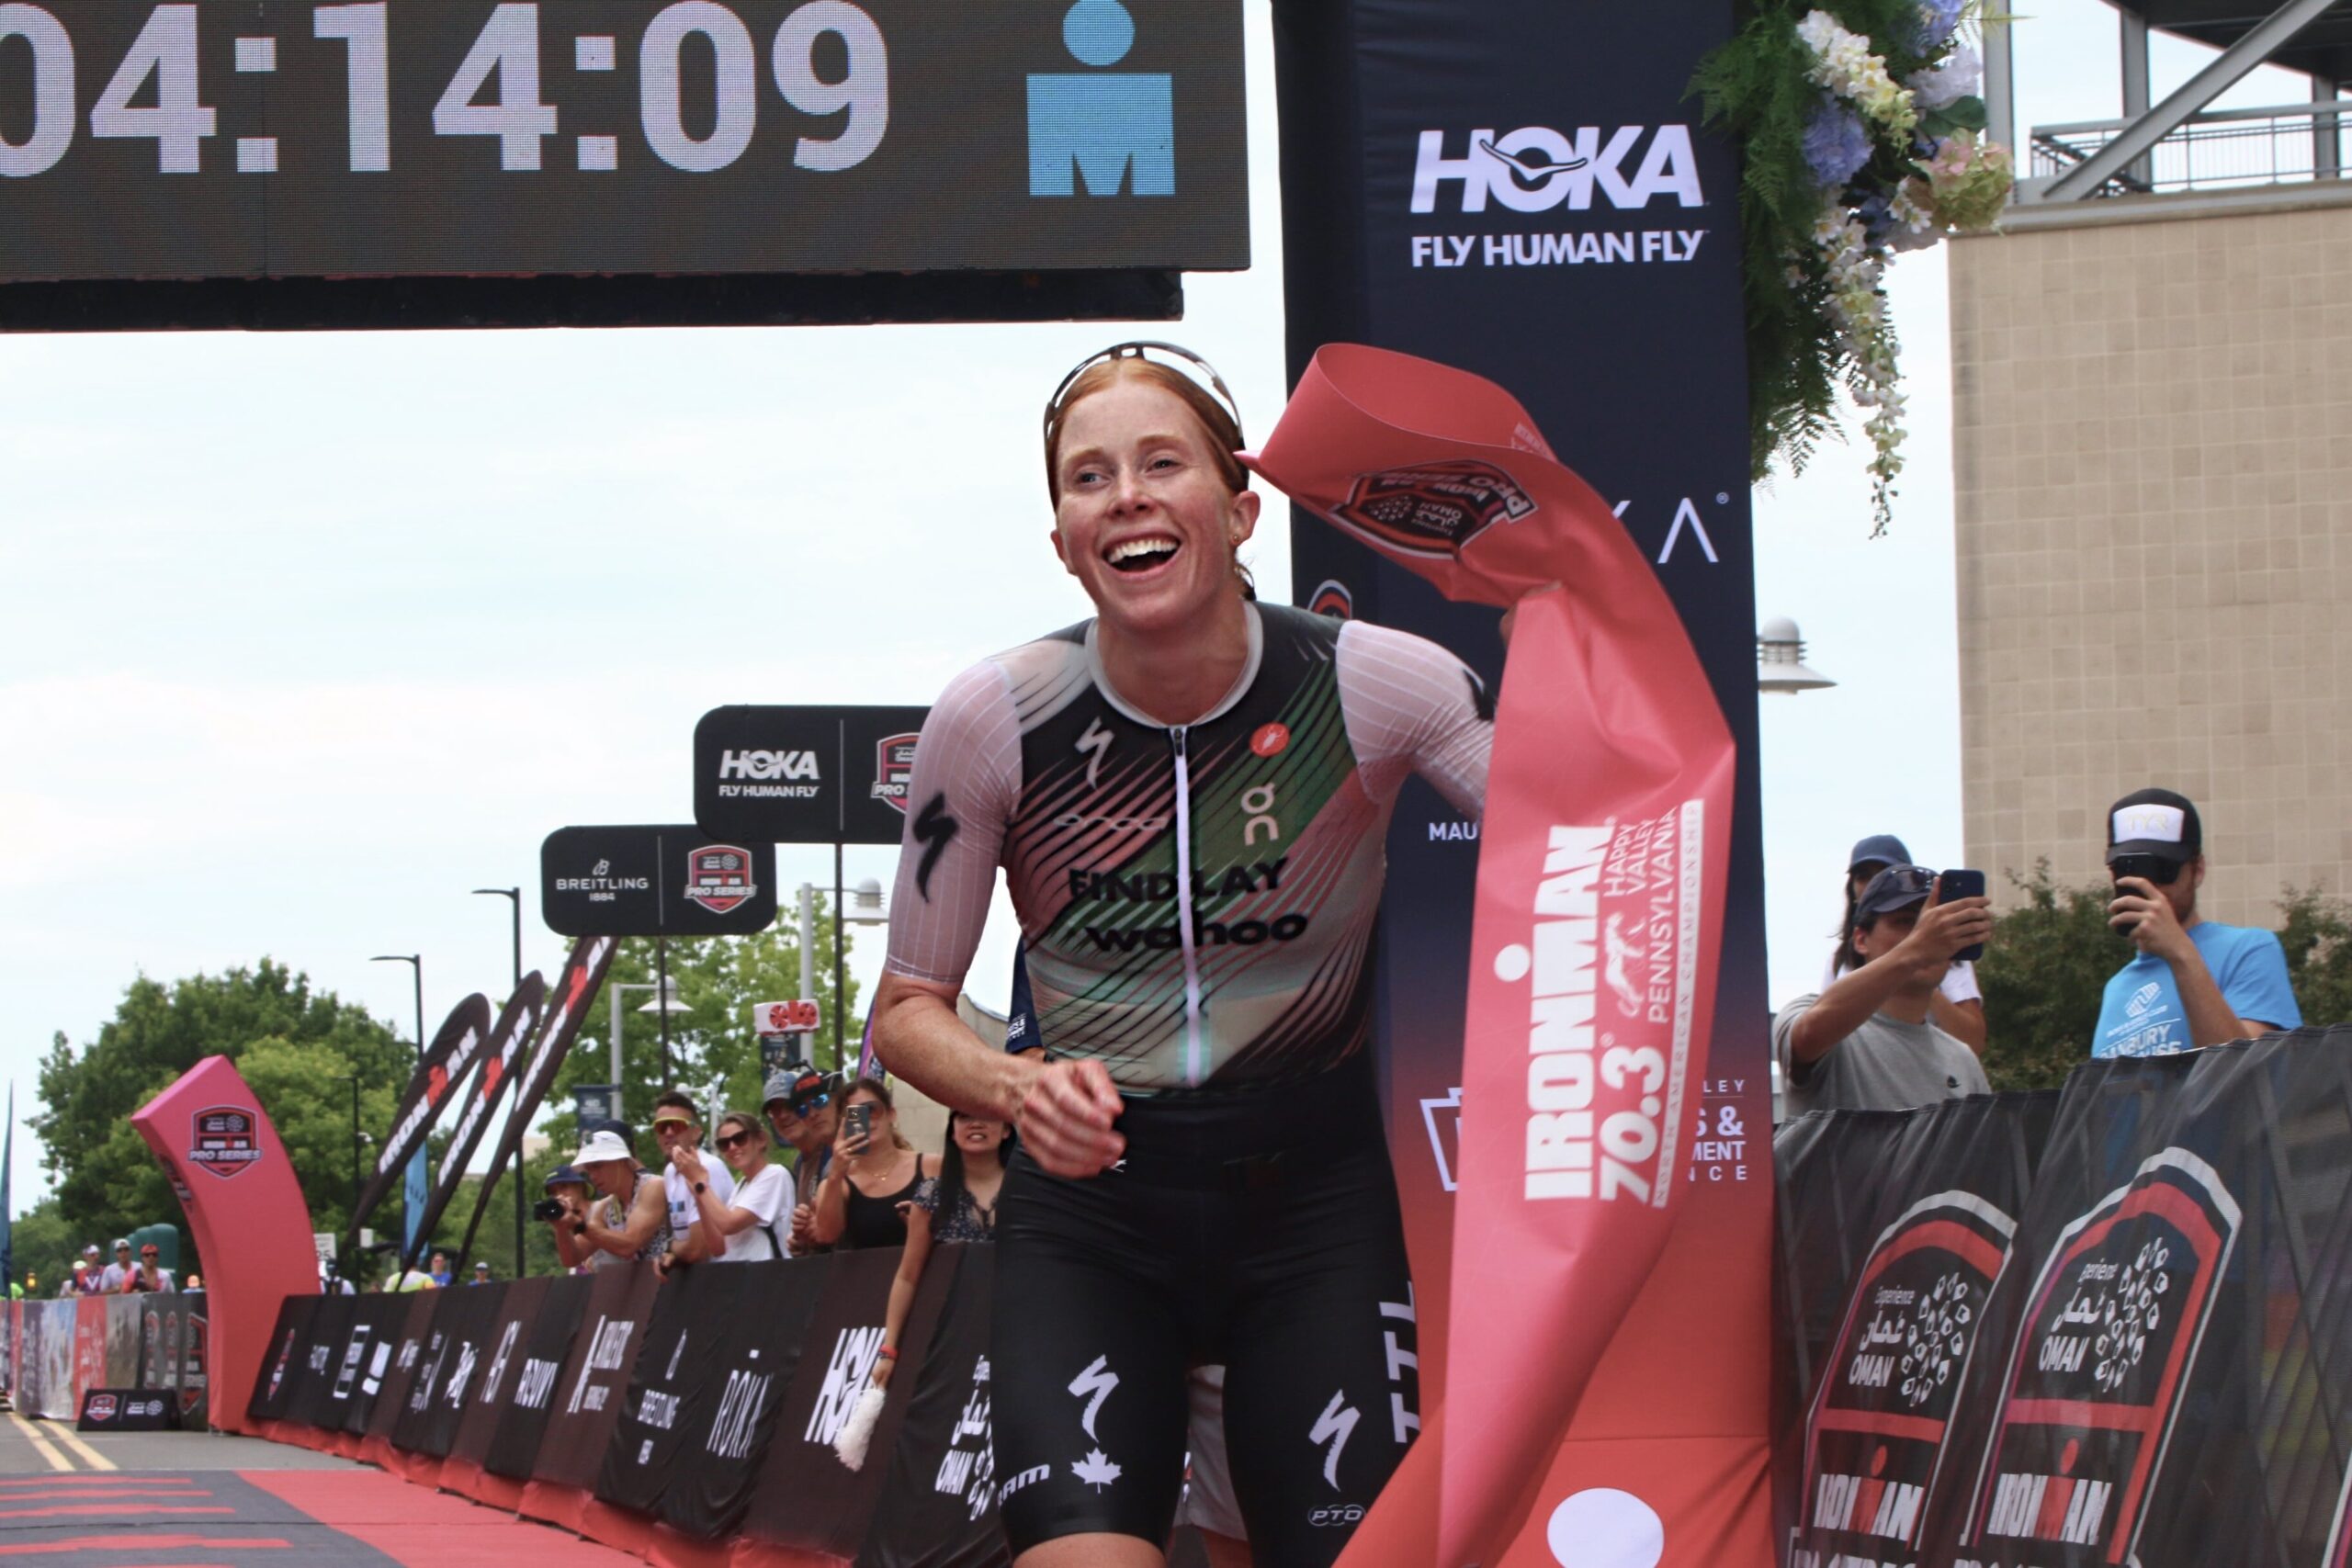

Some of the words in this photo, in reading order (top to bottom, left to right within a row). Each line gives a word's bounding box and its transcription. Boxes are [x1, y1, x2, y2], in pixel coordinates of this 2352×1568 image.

[0, 0, 888, 176] 04:14:09
[1410, 125, 1703, 213] HOKA
[1412, 235, 1476, 267] FLY
[1483, 232, 1634, 266] HUMAN
[1642, 230, 1705, 262] FLY
[718, 750, 820, 780] HOKA
[718, 785, 741, 797] FLY
[743, 785, 794, 797] HUMAN
[796, 785, 820, 797] FLY
[875, 784, 905, 795] PRO
[1429, 821, 1478, 840] MAU
[1603, 824, 1641, 897] HAPPY
[1626, 819, 1657, 896] VALLEY
[556, 877, 649, 890] BREITLING
[589, 893, 616, 901] 1884
[687, 886, 712, 896] PRO
[713, 886, 753, 896] SERIES
[1069, 857, 1288, 902] FINDLAY
[1679, 802, 1700, 982] CHAMPIONSHIP
[1086, 910, 1309, 952] wahoo
[1647, 807, 1679, 1024] PENNSYLVANIA
[1525, 825, 1616, 1201] IRONMAN
[379, 1026, 479, 1174] IRONMAN
[438, 1006, 533, 1187] IRONMAN
[1600, 1045, 1666, 1201] 70.3
[1716, 1105, 1745, 1136] &
[189, 1150, 216, 1160] PRO
[218, 1150, 261, 1159] SERIES
[1849, 1354, 1896, 1388] OMAN
[2038, 1335, 2091, 1372] OMAN
[804, 1325, 887, 1446] HOK
[1311, 1508, 1363, 1523] PTO
[1986, 1472, 2113, 1546] IRONMAN
